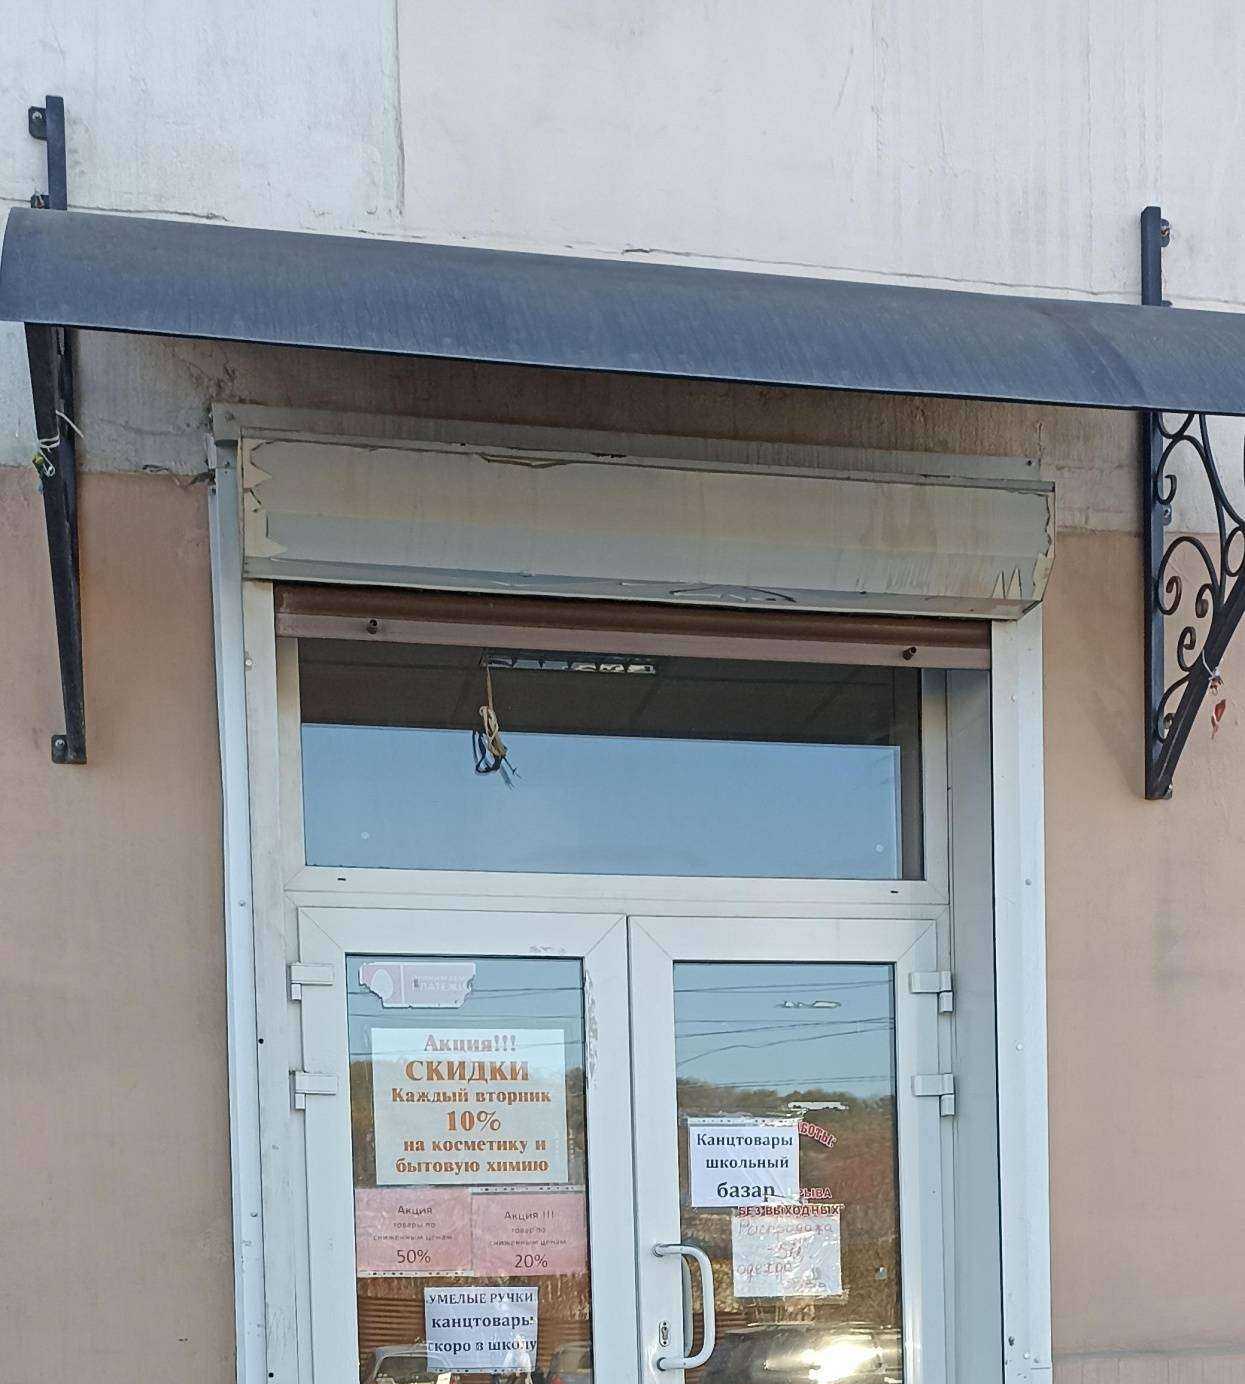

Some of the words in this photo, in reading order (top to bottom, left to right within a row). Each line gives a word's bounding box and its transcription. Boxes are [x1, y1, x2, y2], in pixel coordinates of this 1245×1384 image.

[424, 1034, 517, 1053] Акция!!!
[405, 1060, 529, 1083] СКИДКИ
[392, 1087, 469, 1103] Каждый
[475, 1091, 552, 1105] вторник
[446, 1110, 502, 1132] 10%
[403, 1139, 425, 1151] на
[432, 1139, 528, 1155] косметику
[535, 1139, 547, 1150] и
[696, 1133, 793, 1149] Канцтовары
[395, 1157, 480, 1176] бытовую
[486, 1159, 549, 1172] химию
[705, 1156, 789, 1169] школьный
[716, 1182, 775, 1203] базар
[397, 1205, 433, 1216] Акция
[504, 1211, 539, 1222] Акция
[765, 1204, 840, 1216] ВЫХОДНЫХ
[396, 1249, 431, 1264] 50%
[514, 1254, 548, 1268] 20%
[475, 1341, 484, 1351] в
